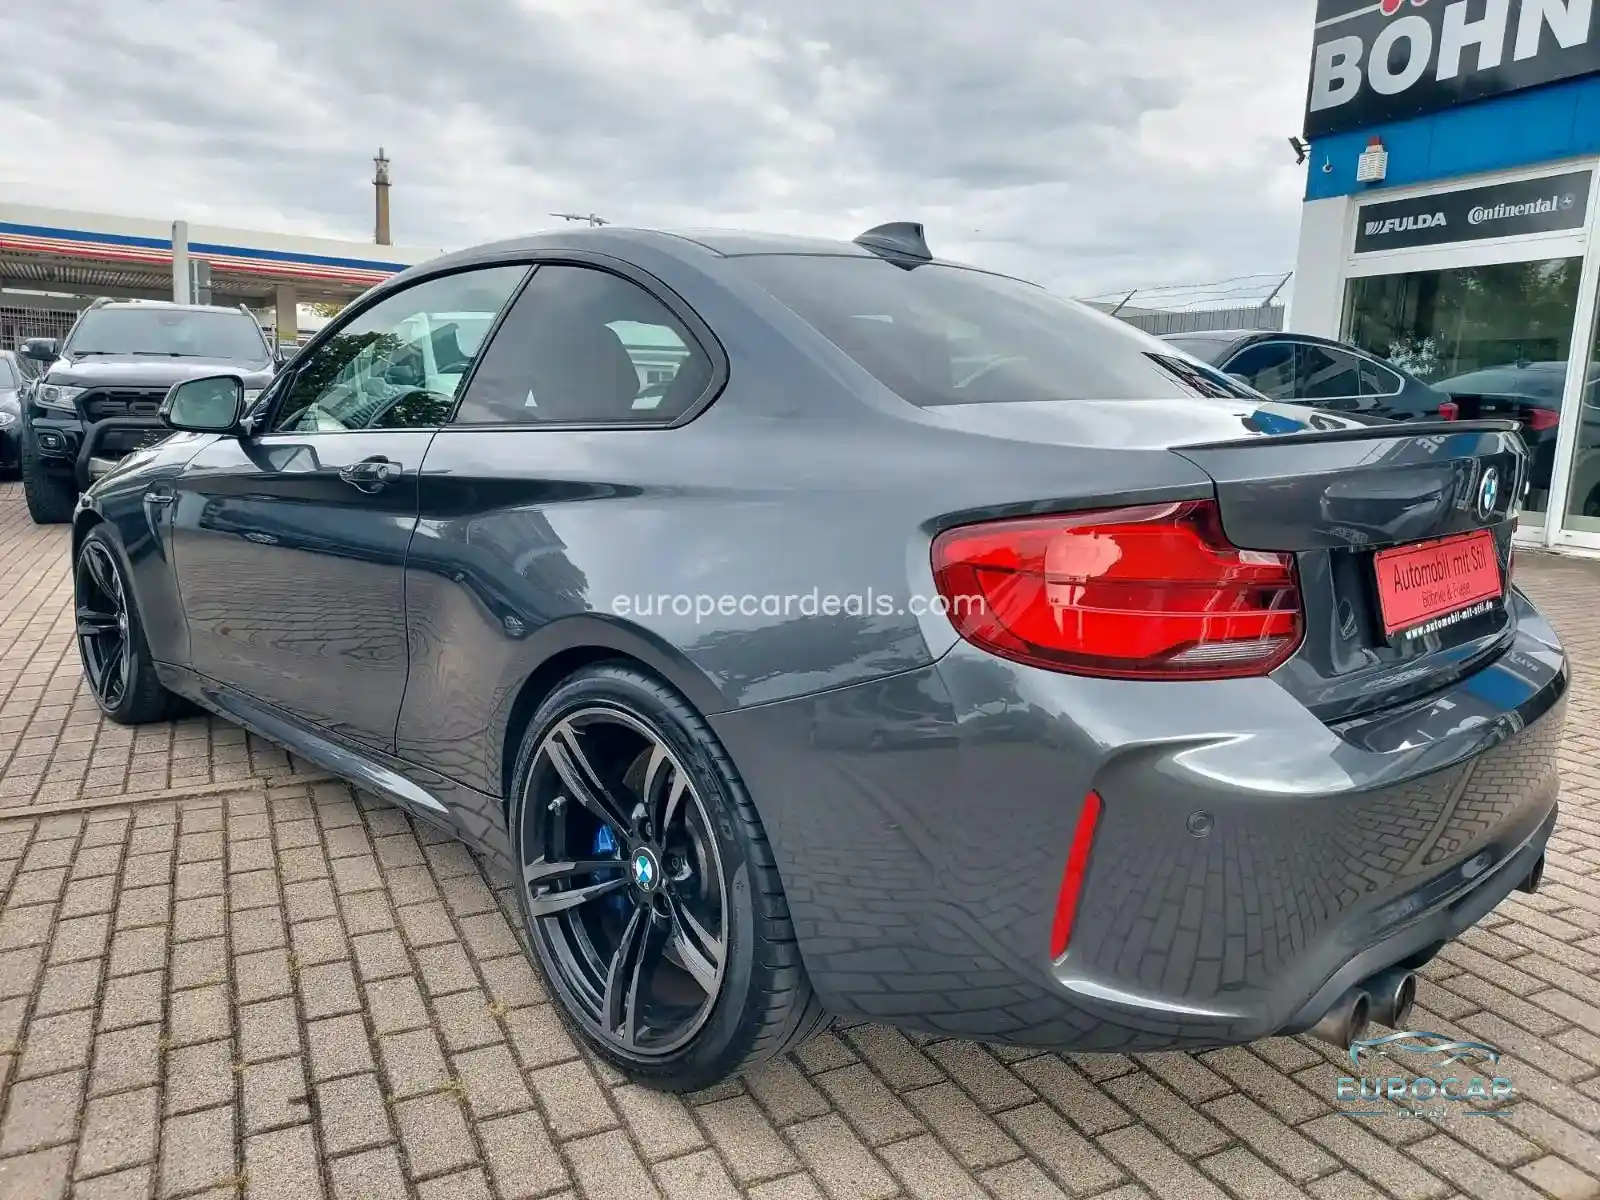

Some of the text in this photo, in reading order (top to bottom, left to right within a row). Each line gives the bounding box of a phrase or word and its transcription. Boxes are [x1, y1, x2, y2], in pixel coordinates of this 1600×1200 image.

[1378, 195, 1558, 234] FULDA Continental
[1393, 544, 1487, 593] Automobil mit Stil
